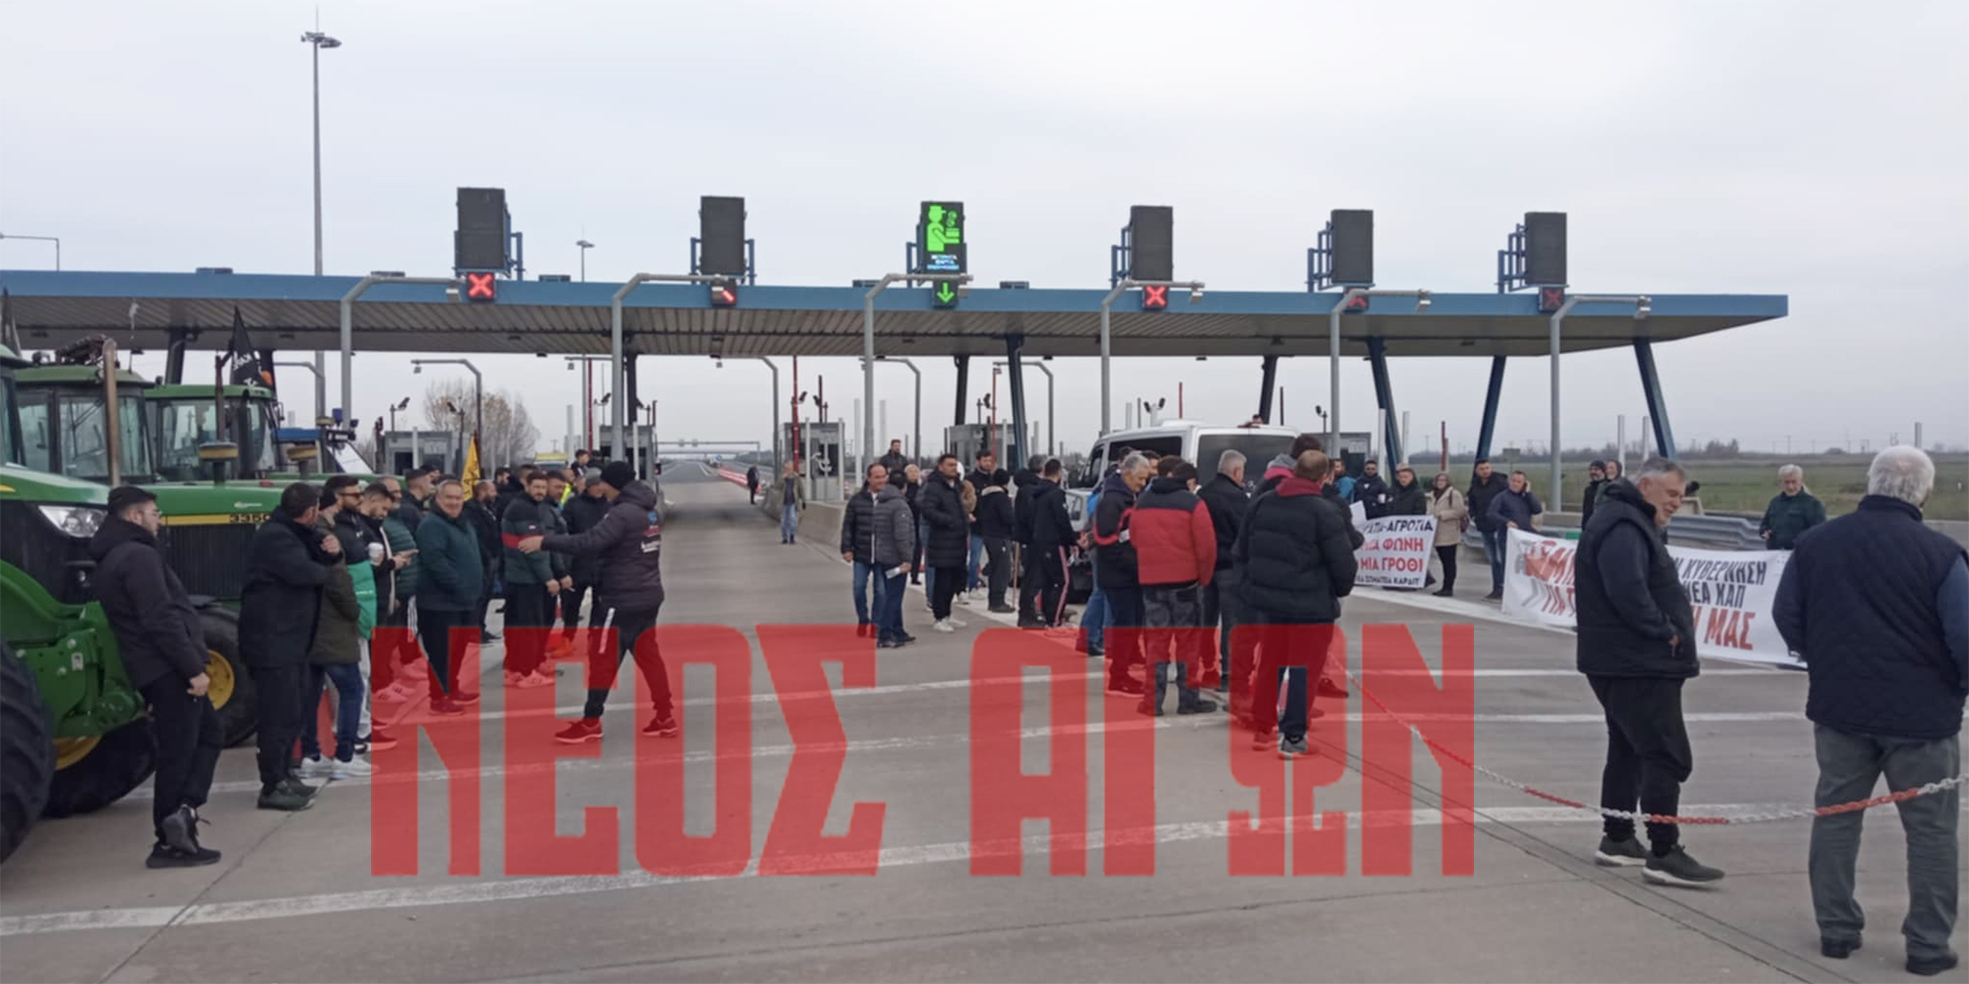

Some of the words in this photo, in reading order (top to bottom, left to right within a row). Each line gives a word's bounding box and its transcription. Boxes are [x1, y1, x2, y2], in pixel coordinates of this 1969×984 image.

[1382, 537, 1424, 552] ΦΩΝΗ
[1360, 557, 1379, 570] ΜΙΑ
[1682, 559, 1767, 585] ΚΥΒΕΡΝΗΣΗ
[1704, 608, 1755, 650] ΜΑΣ
